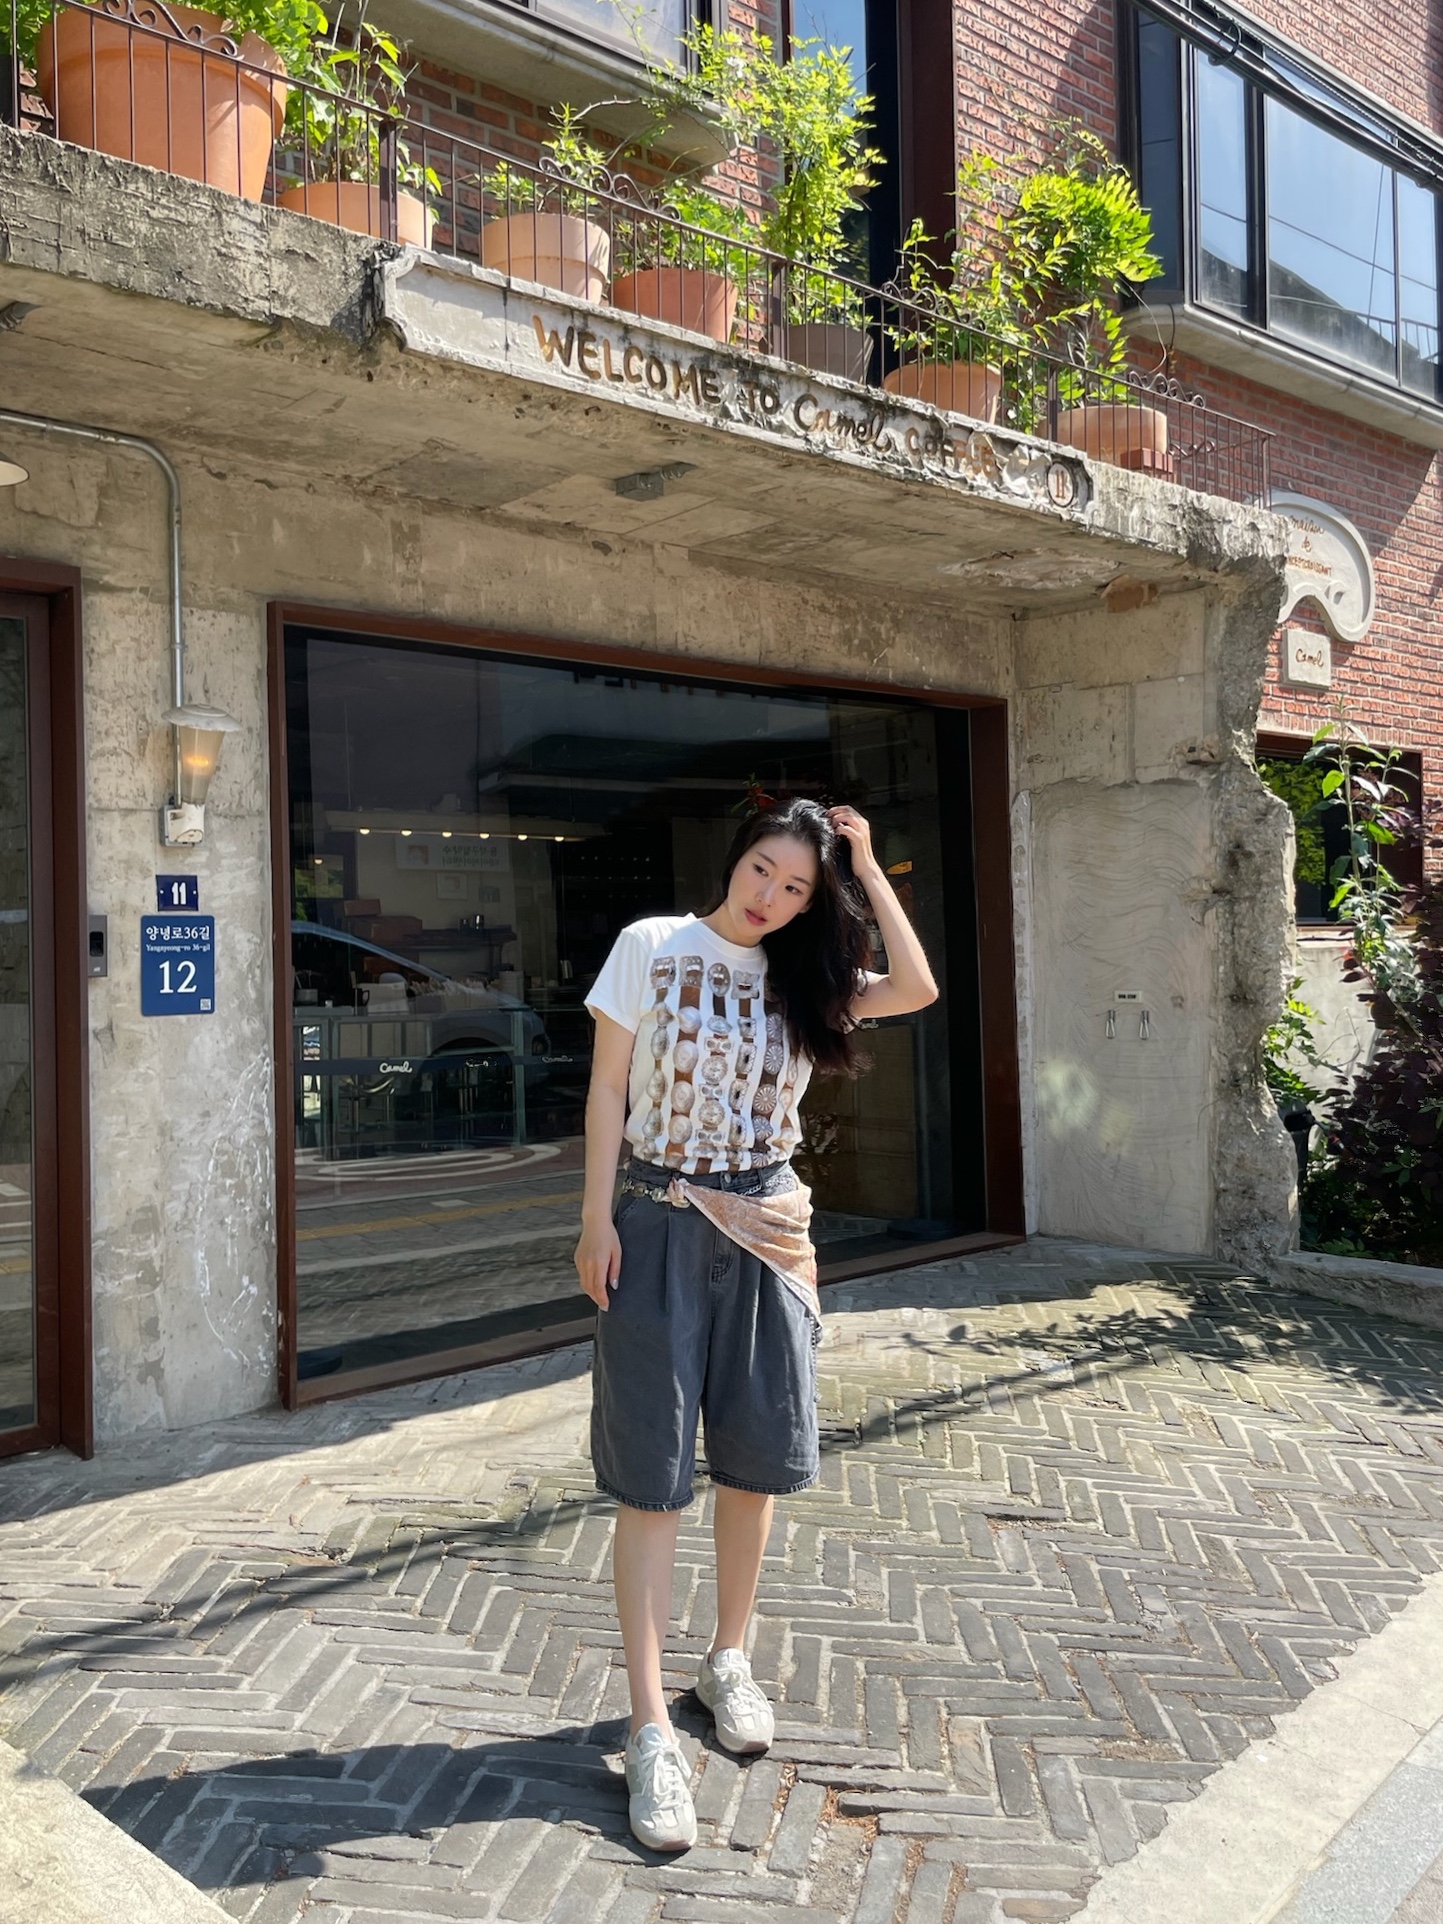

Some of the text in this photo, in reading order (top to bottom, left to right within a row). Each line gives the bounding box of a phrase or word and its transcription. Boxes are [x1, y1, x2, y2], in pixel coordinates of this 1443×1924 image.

[532, 314, 722, 406] WELCOME
[793, 393, 892, 452] Camel
[1295, 648, 1324, 668] Camel
[171, 882, 187, 905] 11
[146, 925, 210, 941] 양녕로36길
[159, 960, 198, 994] 12
[379, 1061, 413, 1074] Camel
